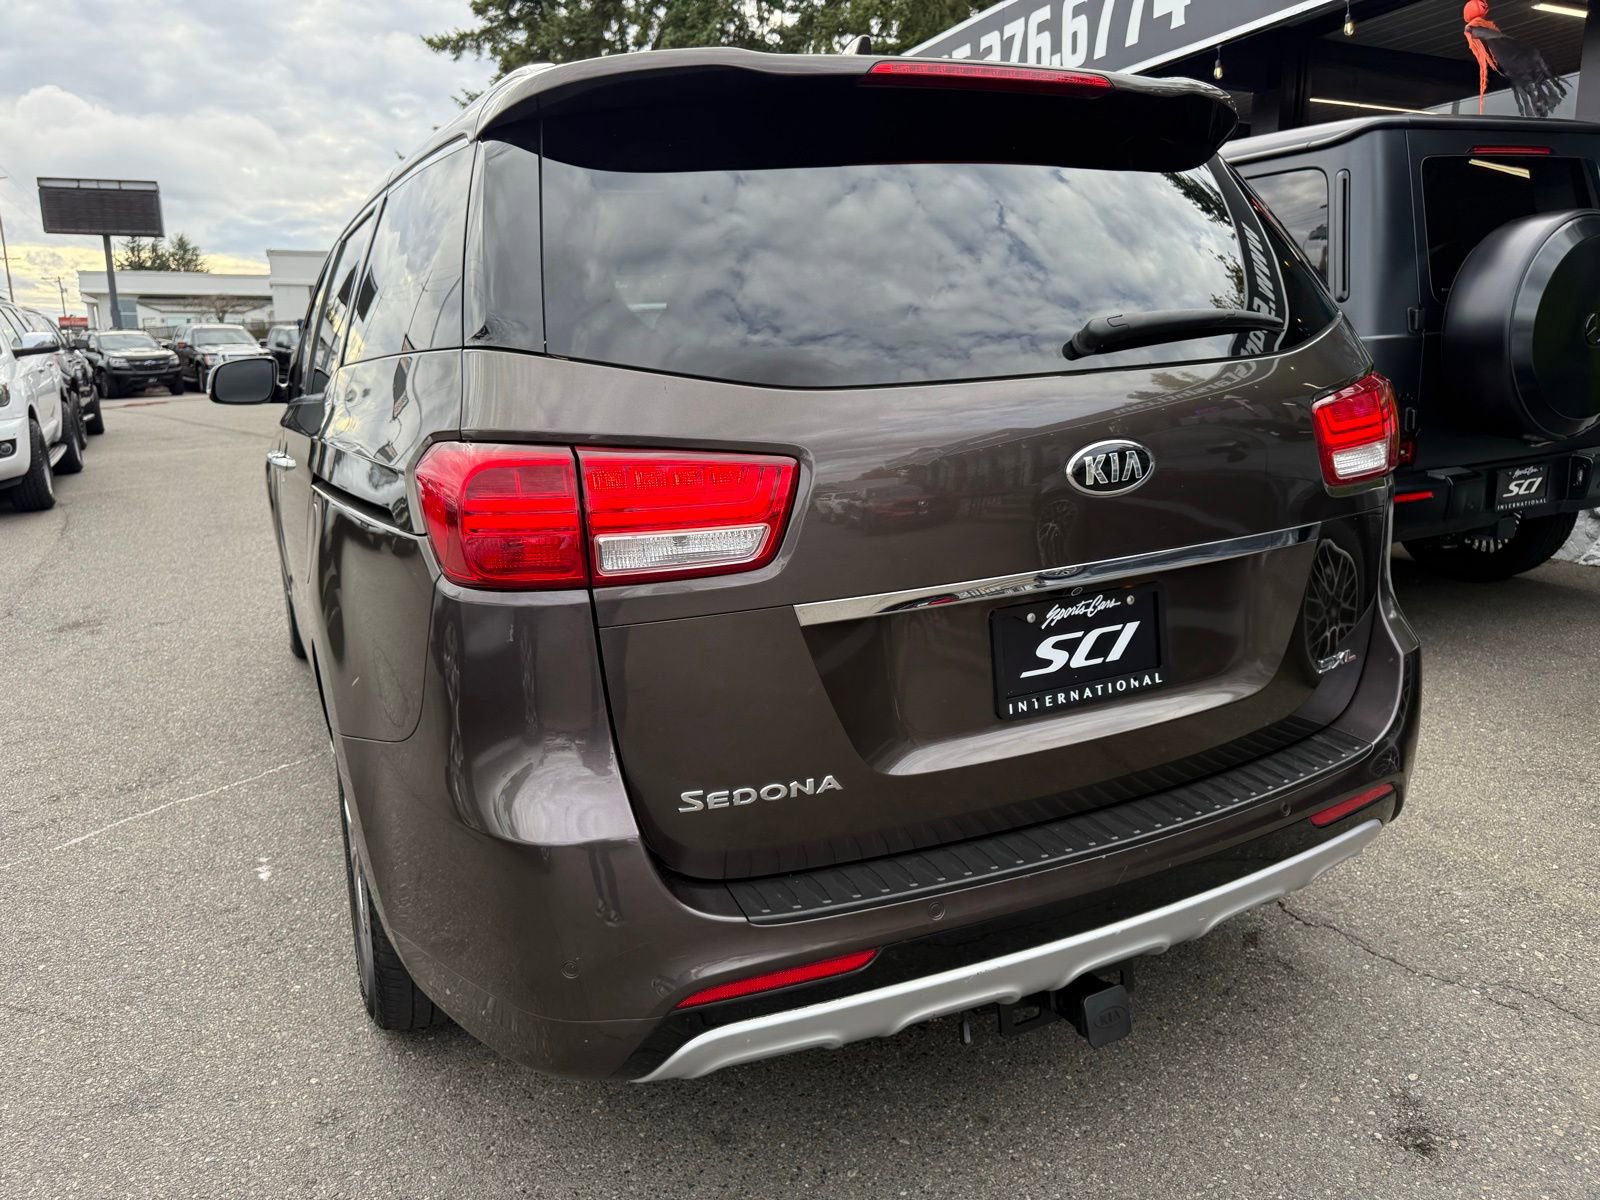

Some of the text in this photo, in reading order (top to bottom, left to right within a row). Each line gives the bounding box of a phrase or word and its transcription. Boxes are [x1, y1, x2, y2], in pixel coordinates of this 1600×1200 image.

[1083, 450, 1143, 486] KIA
[1041, 594, 1122, 630] Sports Cars
[1019, 620, 1141, 679] SCI
[1008, 672, 1164, 715] INTERNATIONAL
[678, 775, 844, 813] SEDONA
